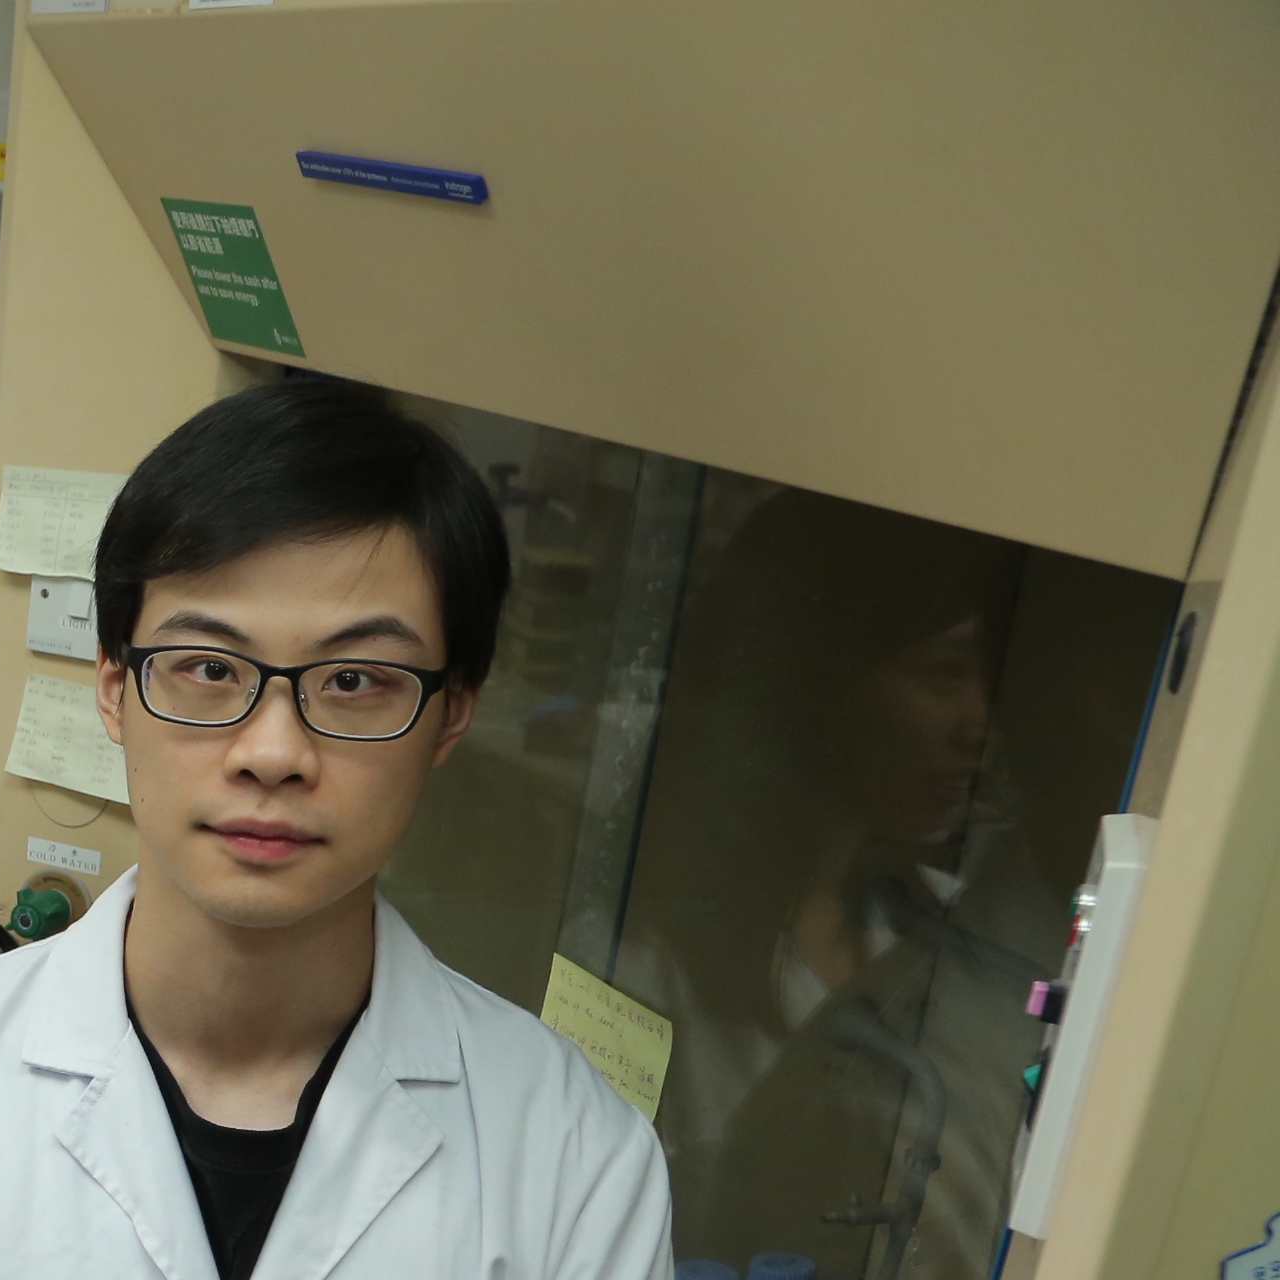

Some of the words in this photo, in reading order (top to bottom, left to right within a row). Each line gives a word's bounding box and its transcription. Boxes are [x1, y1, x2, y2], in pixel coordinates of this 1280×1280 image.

[191, 265, 214, 281] Please
[232, 272, 243, 285] the
[62, 618, 94, 633] LIGHT
[29, 850, 57, 863] COLD
[61, 857, 99, 873] WATER
